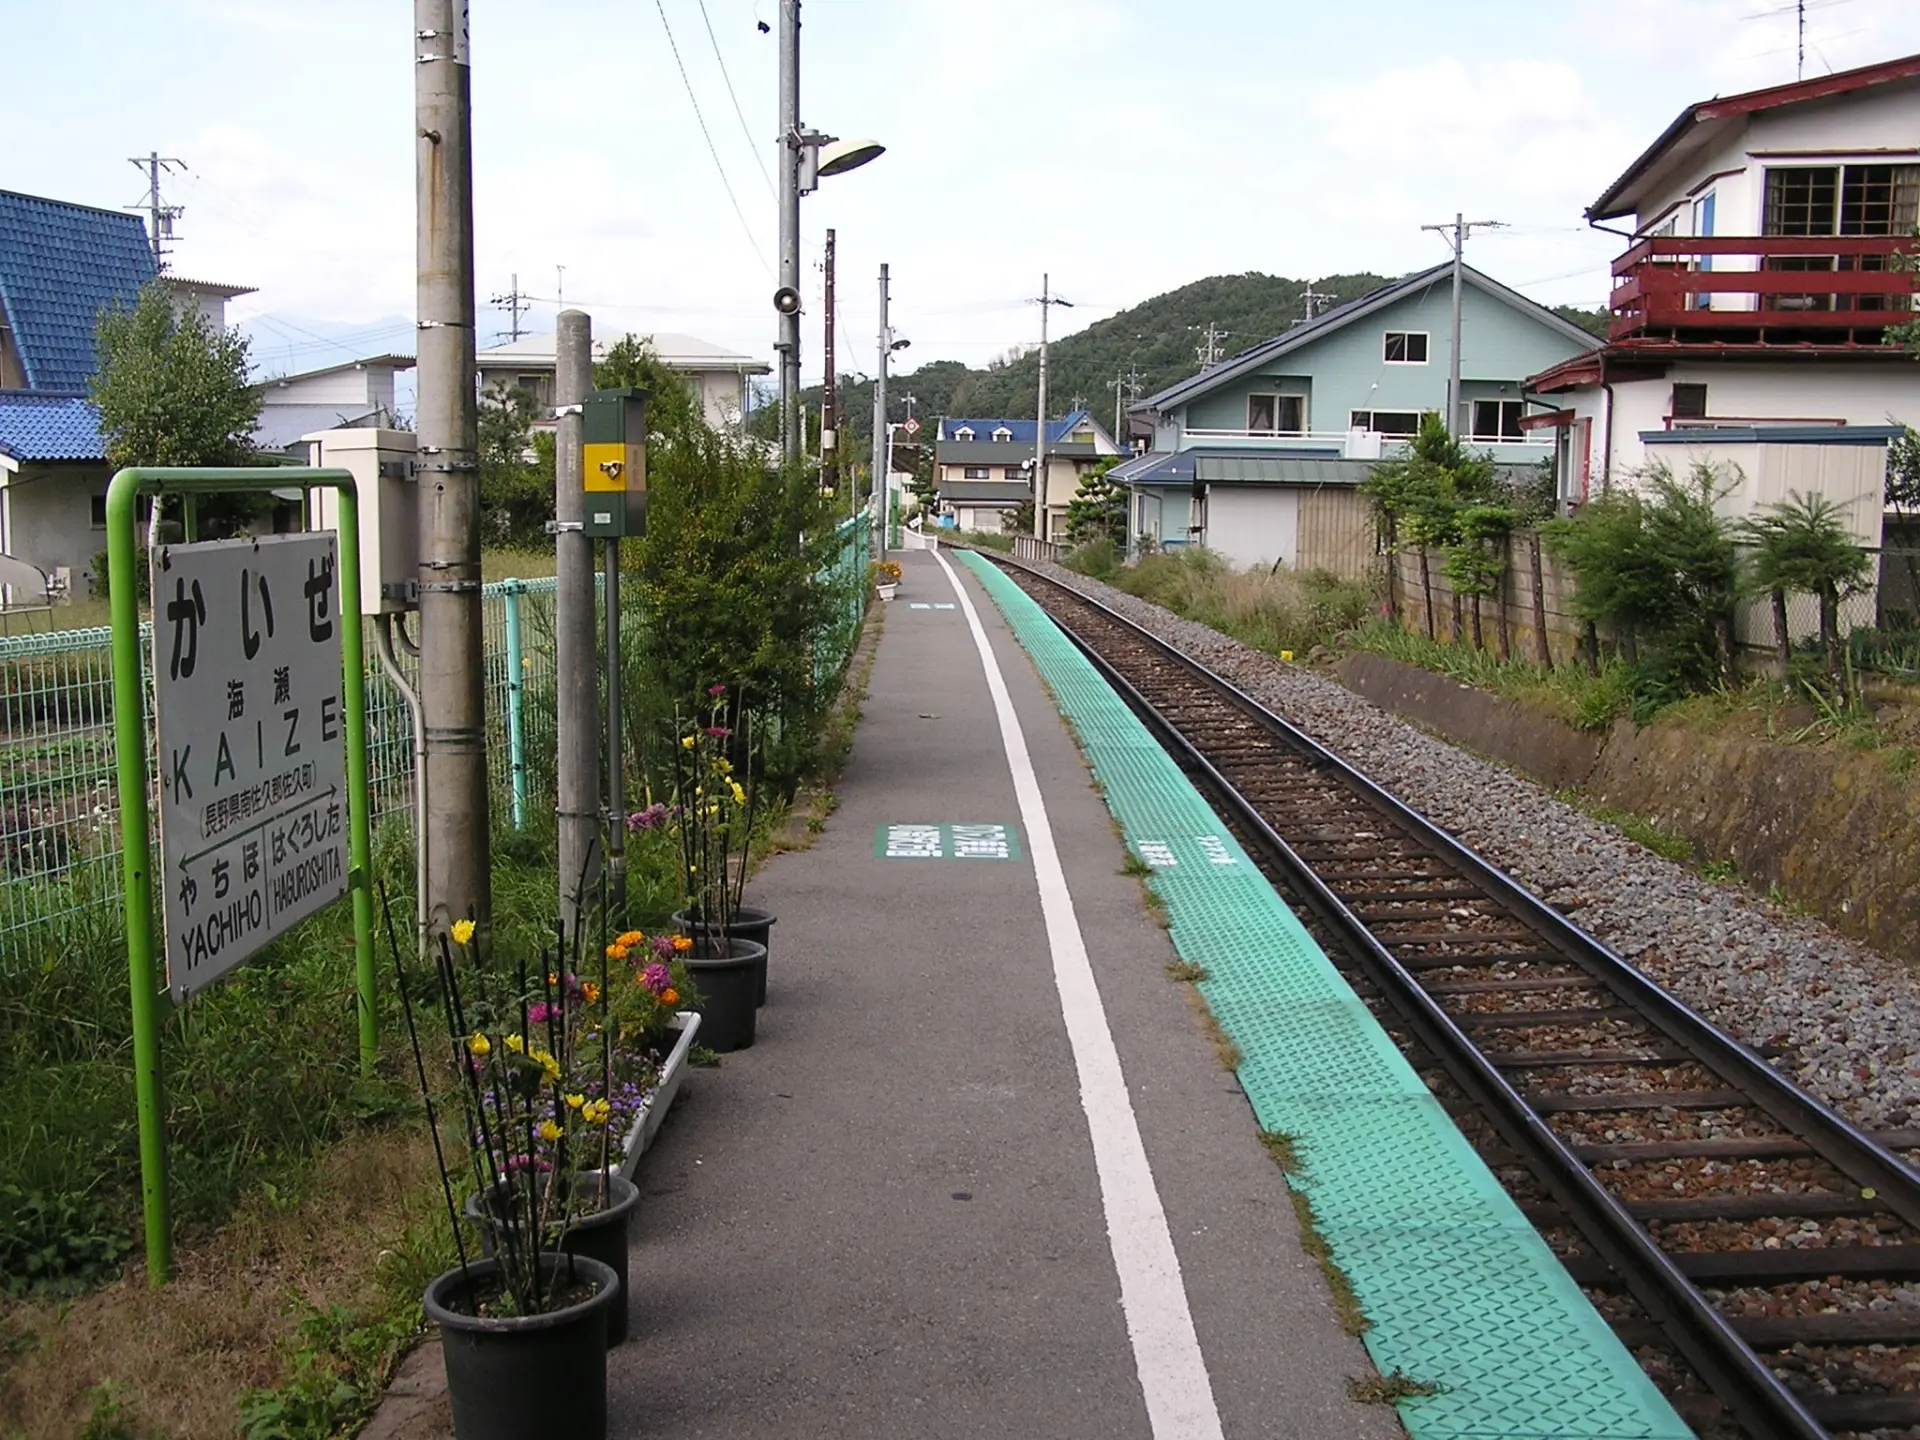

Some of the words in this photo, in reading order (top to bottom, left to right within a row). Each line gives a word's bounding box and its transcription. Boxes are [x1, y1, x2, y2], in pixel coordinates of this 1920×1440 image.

[167, 552, 334, 681] かいぜ
[173, 696, 338, 804] KAIZE
[271, 802, 341, 866] はぐろした
[179, 841, 260, 916] やちほ
[273, 846, 342, 915] HAGUROSHITA
[181, 889, 262, 971] YACHIHO
